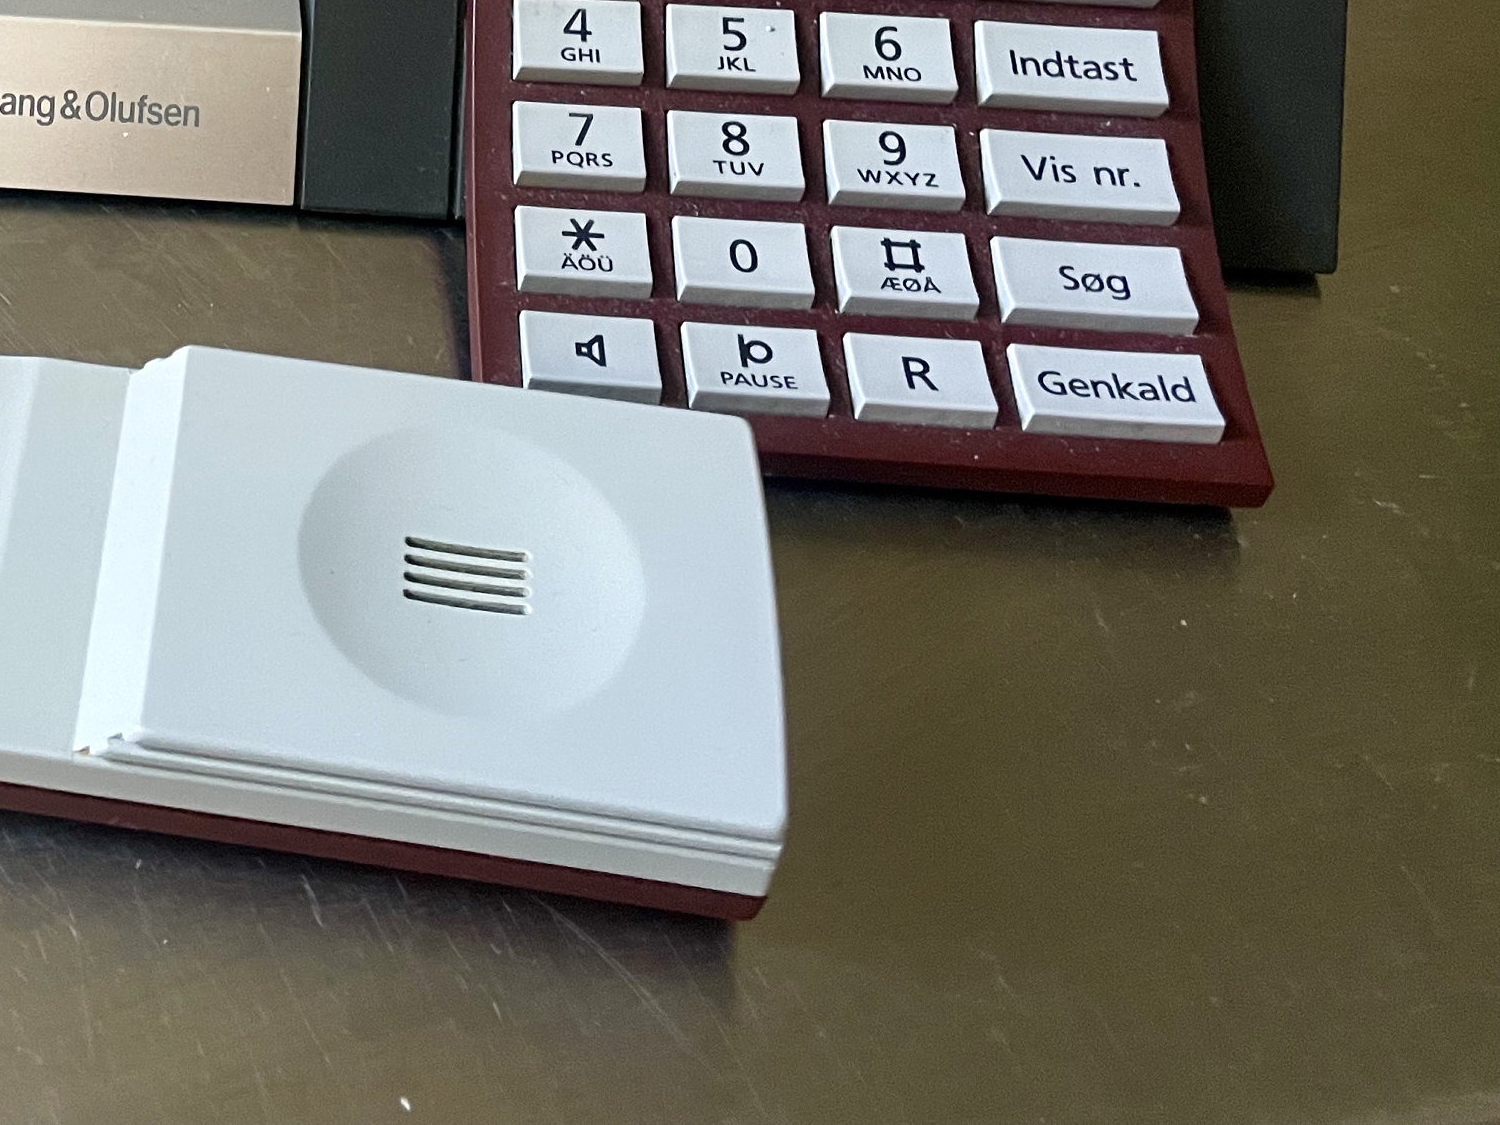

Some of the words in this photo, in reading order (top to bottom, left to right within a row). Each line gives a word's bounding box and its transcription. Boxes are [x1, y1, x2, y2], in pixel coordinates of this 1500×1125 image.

[562, 8, 593, 43] 4
[722, 16, 747, 52] 5
[560, 46, 601, 64] GHI
[874, 25, 902, 62] 6
[717, 55, 757, 73] JKL
[862, 64, 922, 82] MNO
[1009, 49, 1138, 82] Indtast
[568, 112, 594, 147] 7
[721, 120, 750, 157] 8
[551, 149, 614, 169] PQRS
[878, 130, 907, 167] 9
[712, 160, 765, 177] TUV
[856, 168, 939, 188] WXYZ
[1020, 154, 1077, 184] Vis
[1093, 166, 1141, 188] nr.
[561, 252, 614, 273] ÄÖÜ
[880, 276, 942, 294] ÆØÅ
[1058, 265, 1132, 301] Søg
[720, 371, 799, 390] PAUSE
[901, 355, 933, 391] R
[1037, 370, 1197, 403] Genkald
